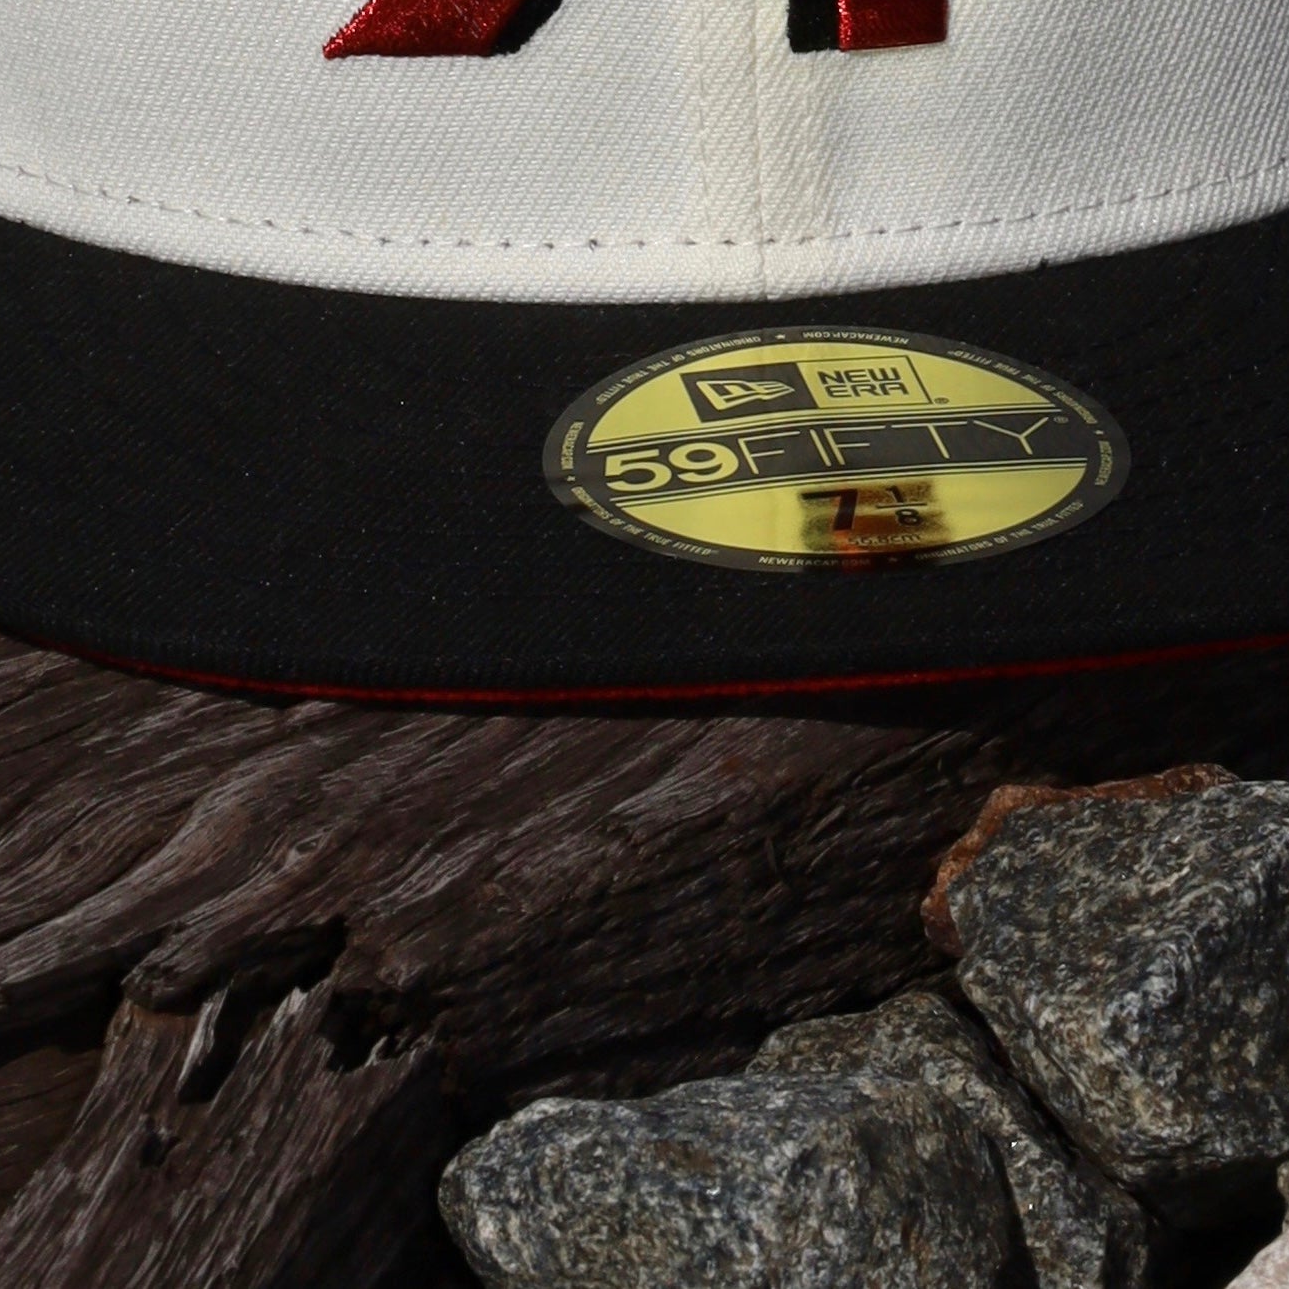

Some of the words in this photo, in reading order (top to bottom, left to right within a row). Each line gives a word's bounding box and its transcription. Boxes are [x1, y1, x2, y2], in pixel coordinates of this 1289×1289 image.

[817, 367, 902, 385] NEW
[824, 382, 910, 398] ERA
[604, 416, 1051, 492] 59FIFTY
[800, 488, 859, 532] 7
